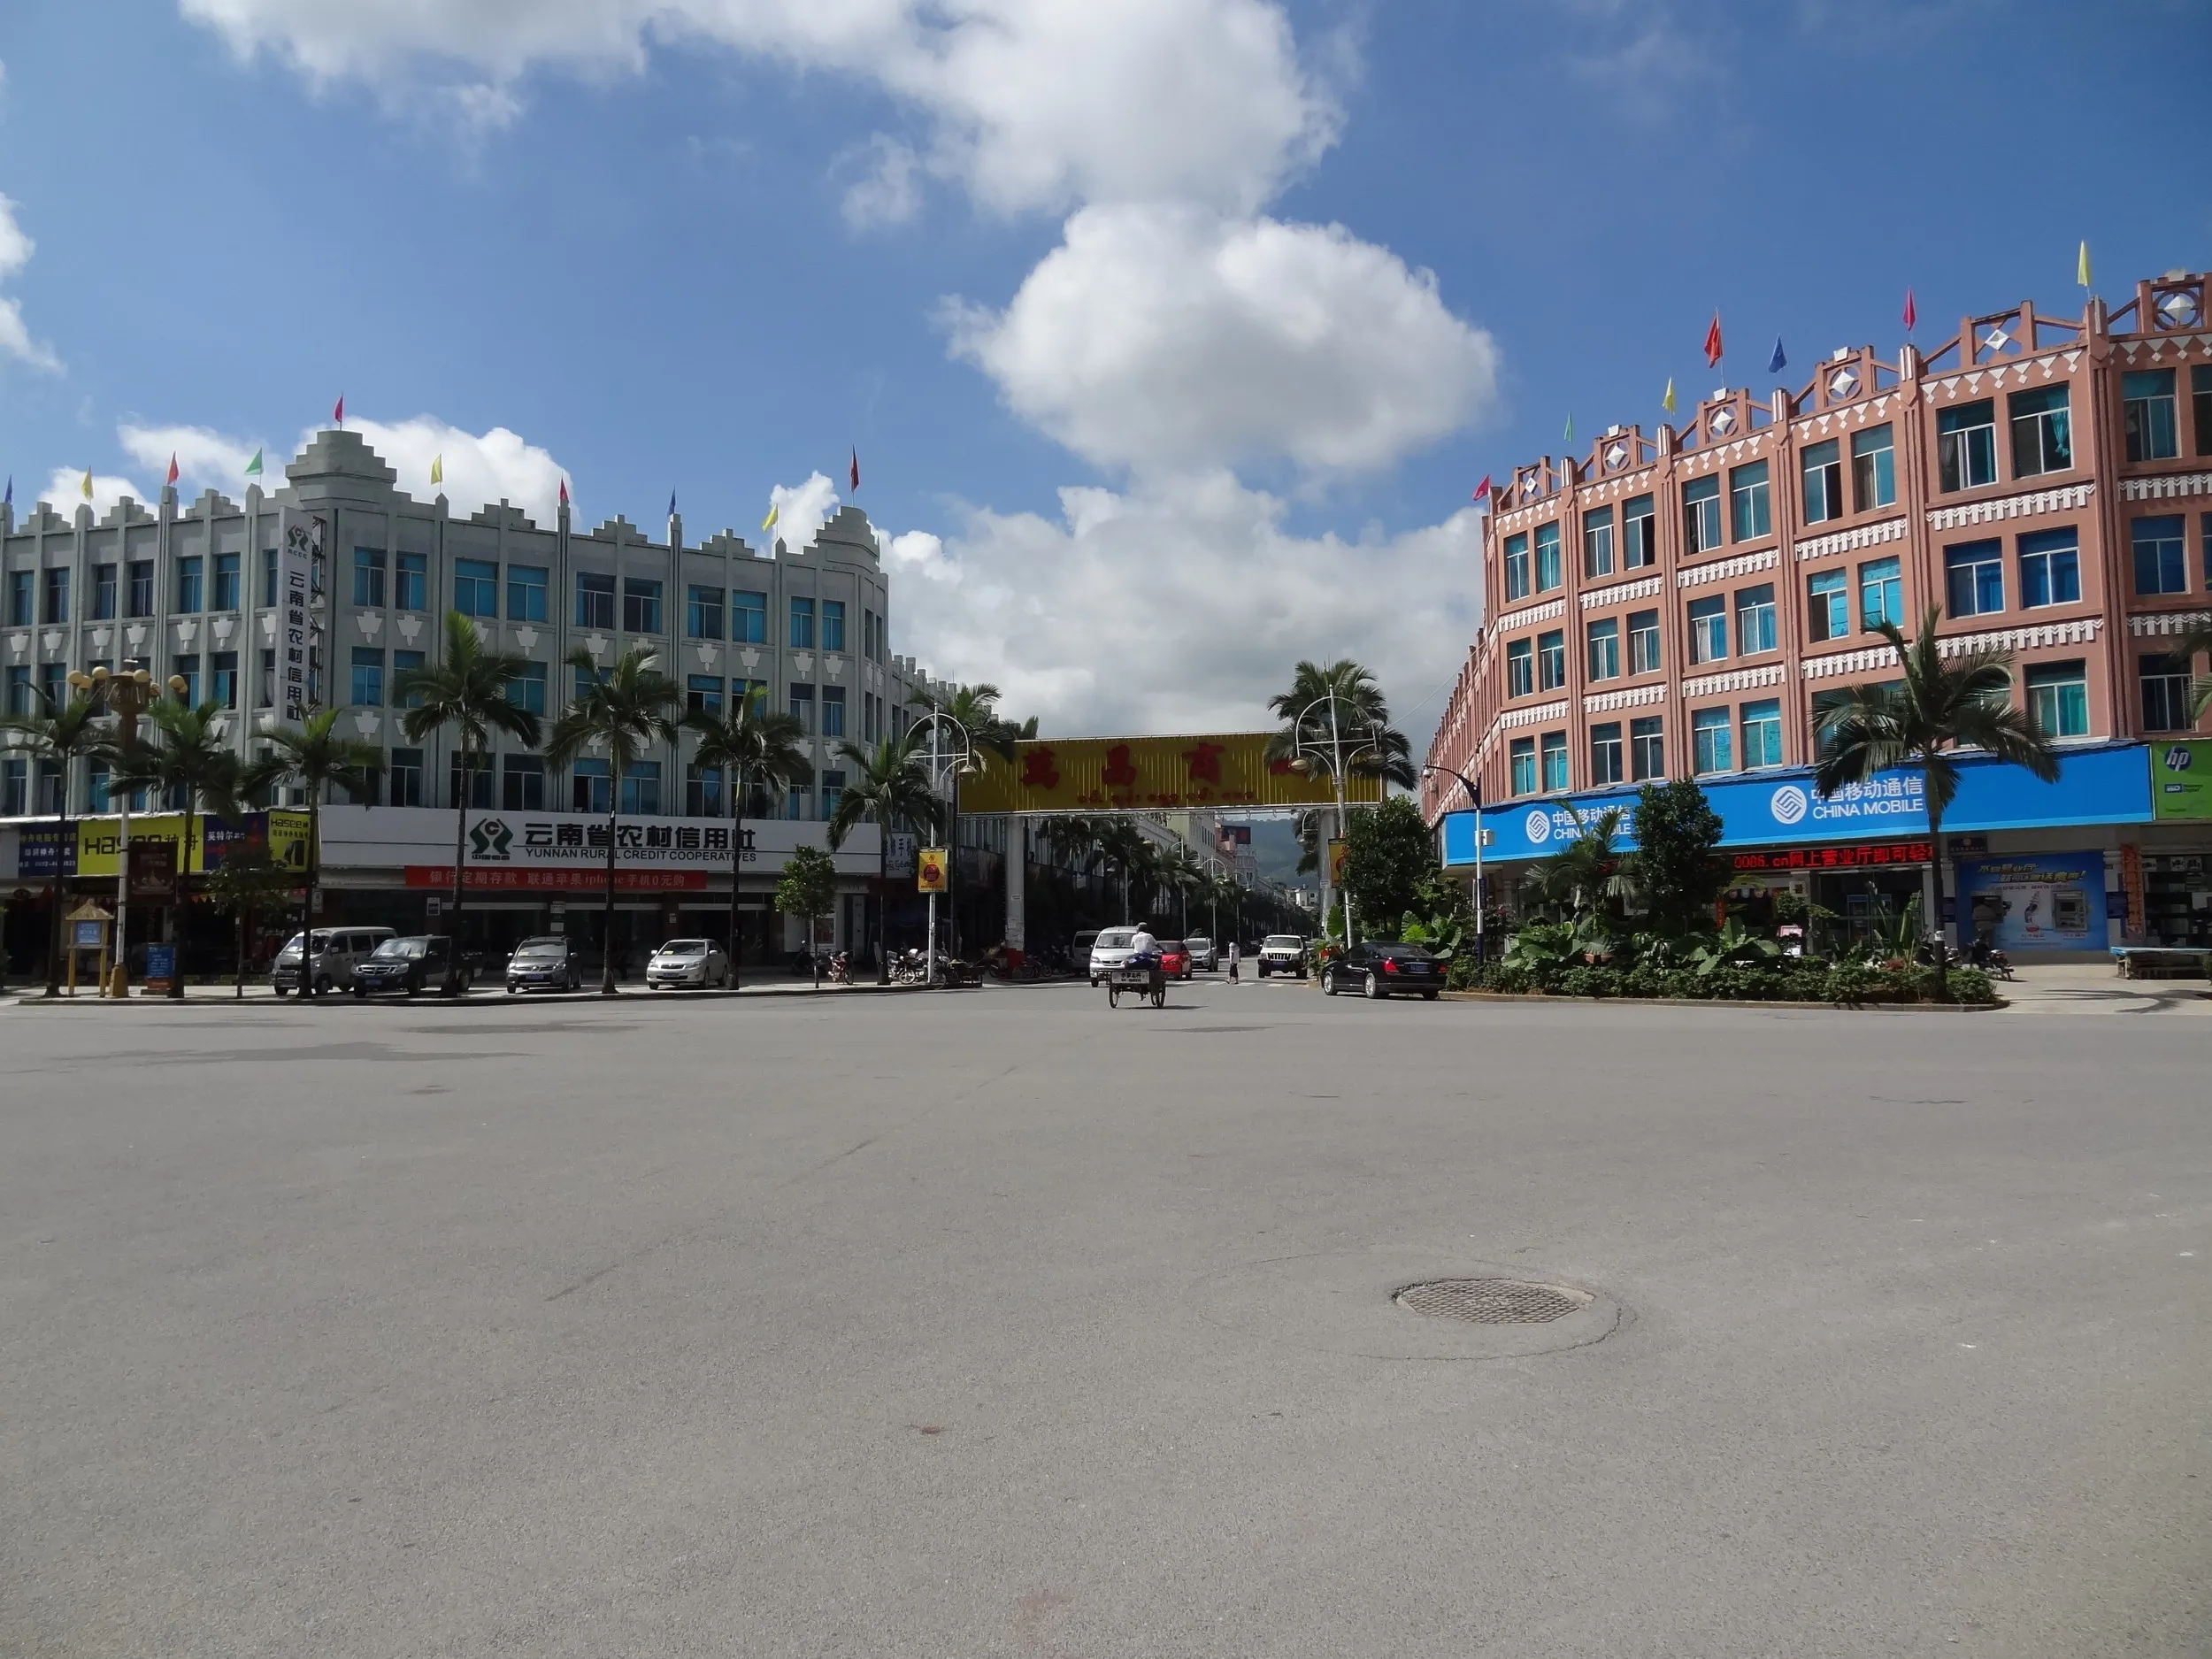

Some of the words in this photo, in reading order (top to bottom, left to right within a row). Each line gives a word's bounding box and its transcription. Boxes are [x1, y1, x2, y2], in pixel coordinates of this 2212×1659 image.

[287, 570, 304, 722] 云南省农村信用社
[2166, 746, 2189, 772] hp
[1810, 775, 1923, 805] 中国移动通信
[1812, 802, 1861, 820] CHINA
[1863, 798, 1924, 816] MOBILE
[525, 823, 757, 851] 云南省农村信用社
[526, 848, 578, 859] YUNNAN
[580, 849, 621, 860] RURL
[623, 849, 667, 860] CREDIT
[429, 870, 518, 885] 银行定期存款
